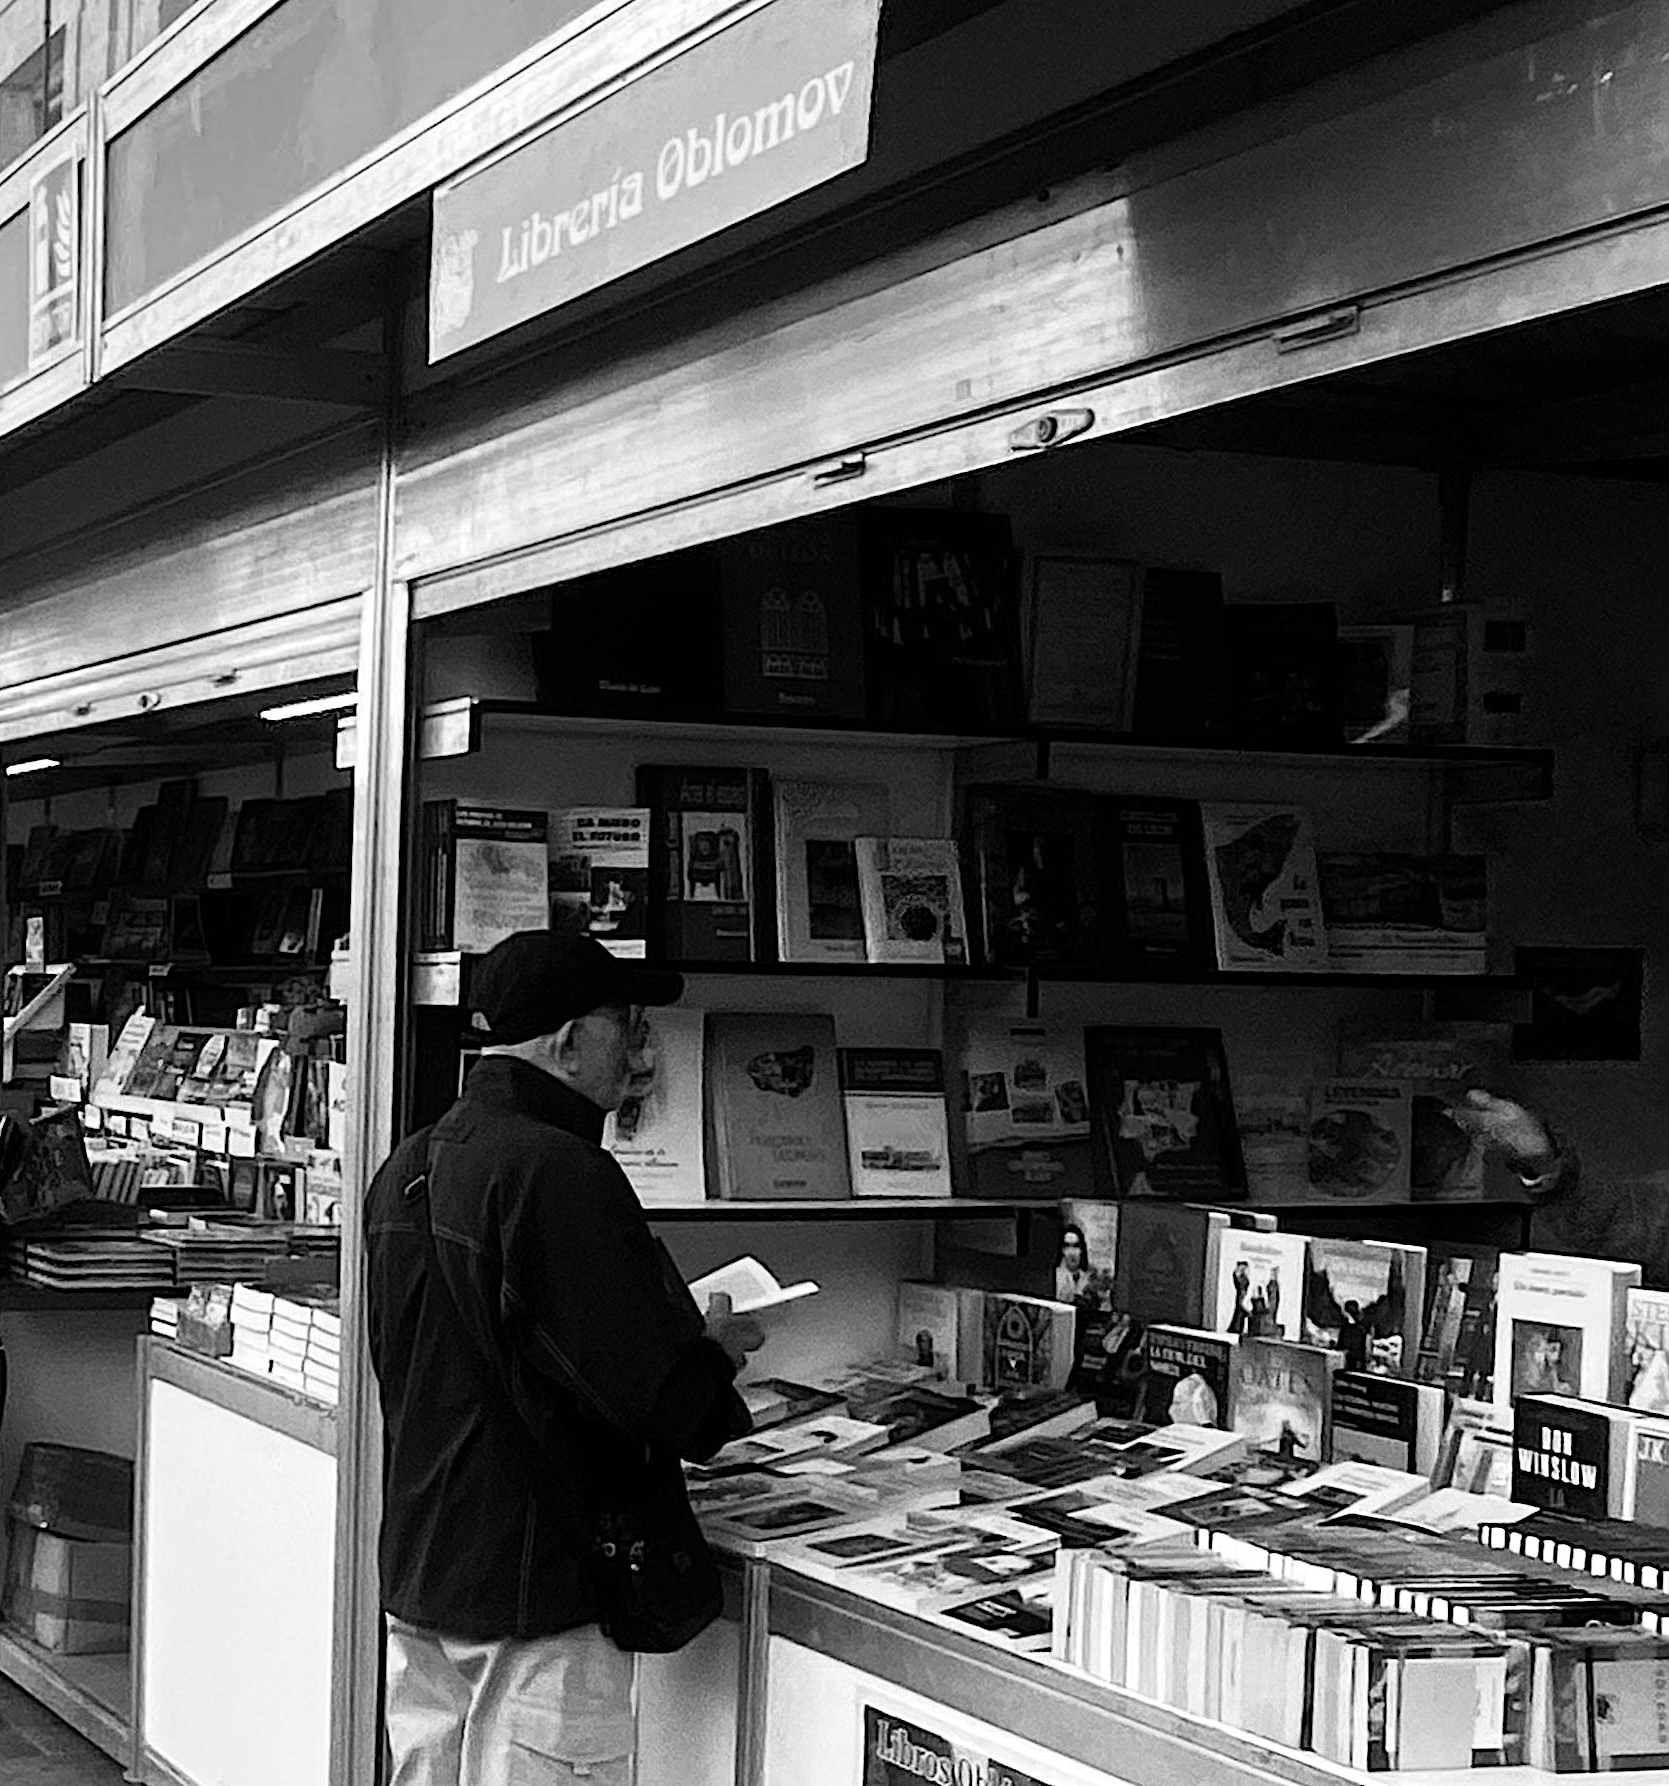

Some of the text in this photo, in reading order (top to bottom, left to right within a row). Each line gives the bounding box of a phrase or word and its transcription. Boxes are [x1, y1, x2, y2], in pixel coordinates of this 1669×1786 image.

[495, 60, 855, 284] Librería Oblomov
[1518, 1447, 1597, 1490] WINSLOW
[1541, 1426, 1573, 1457] DON
[875, 1717, 953, 1786] Libros
